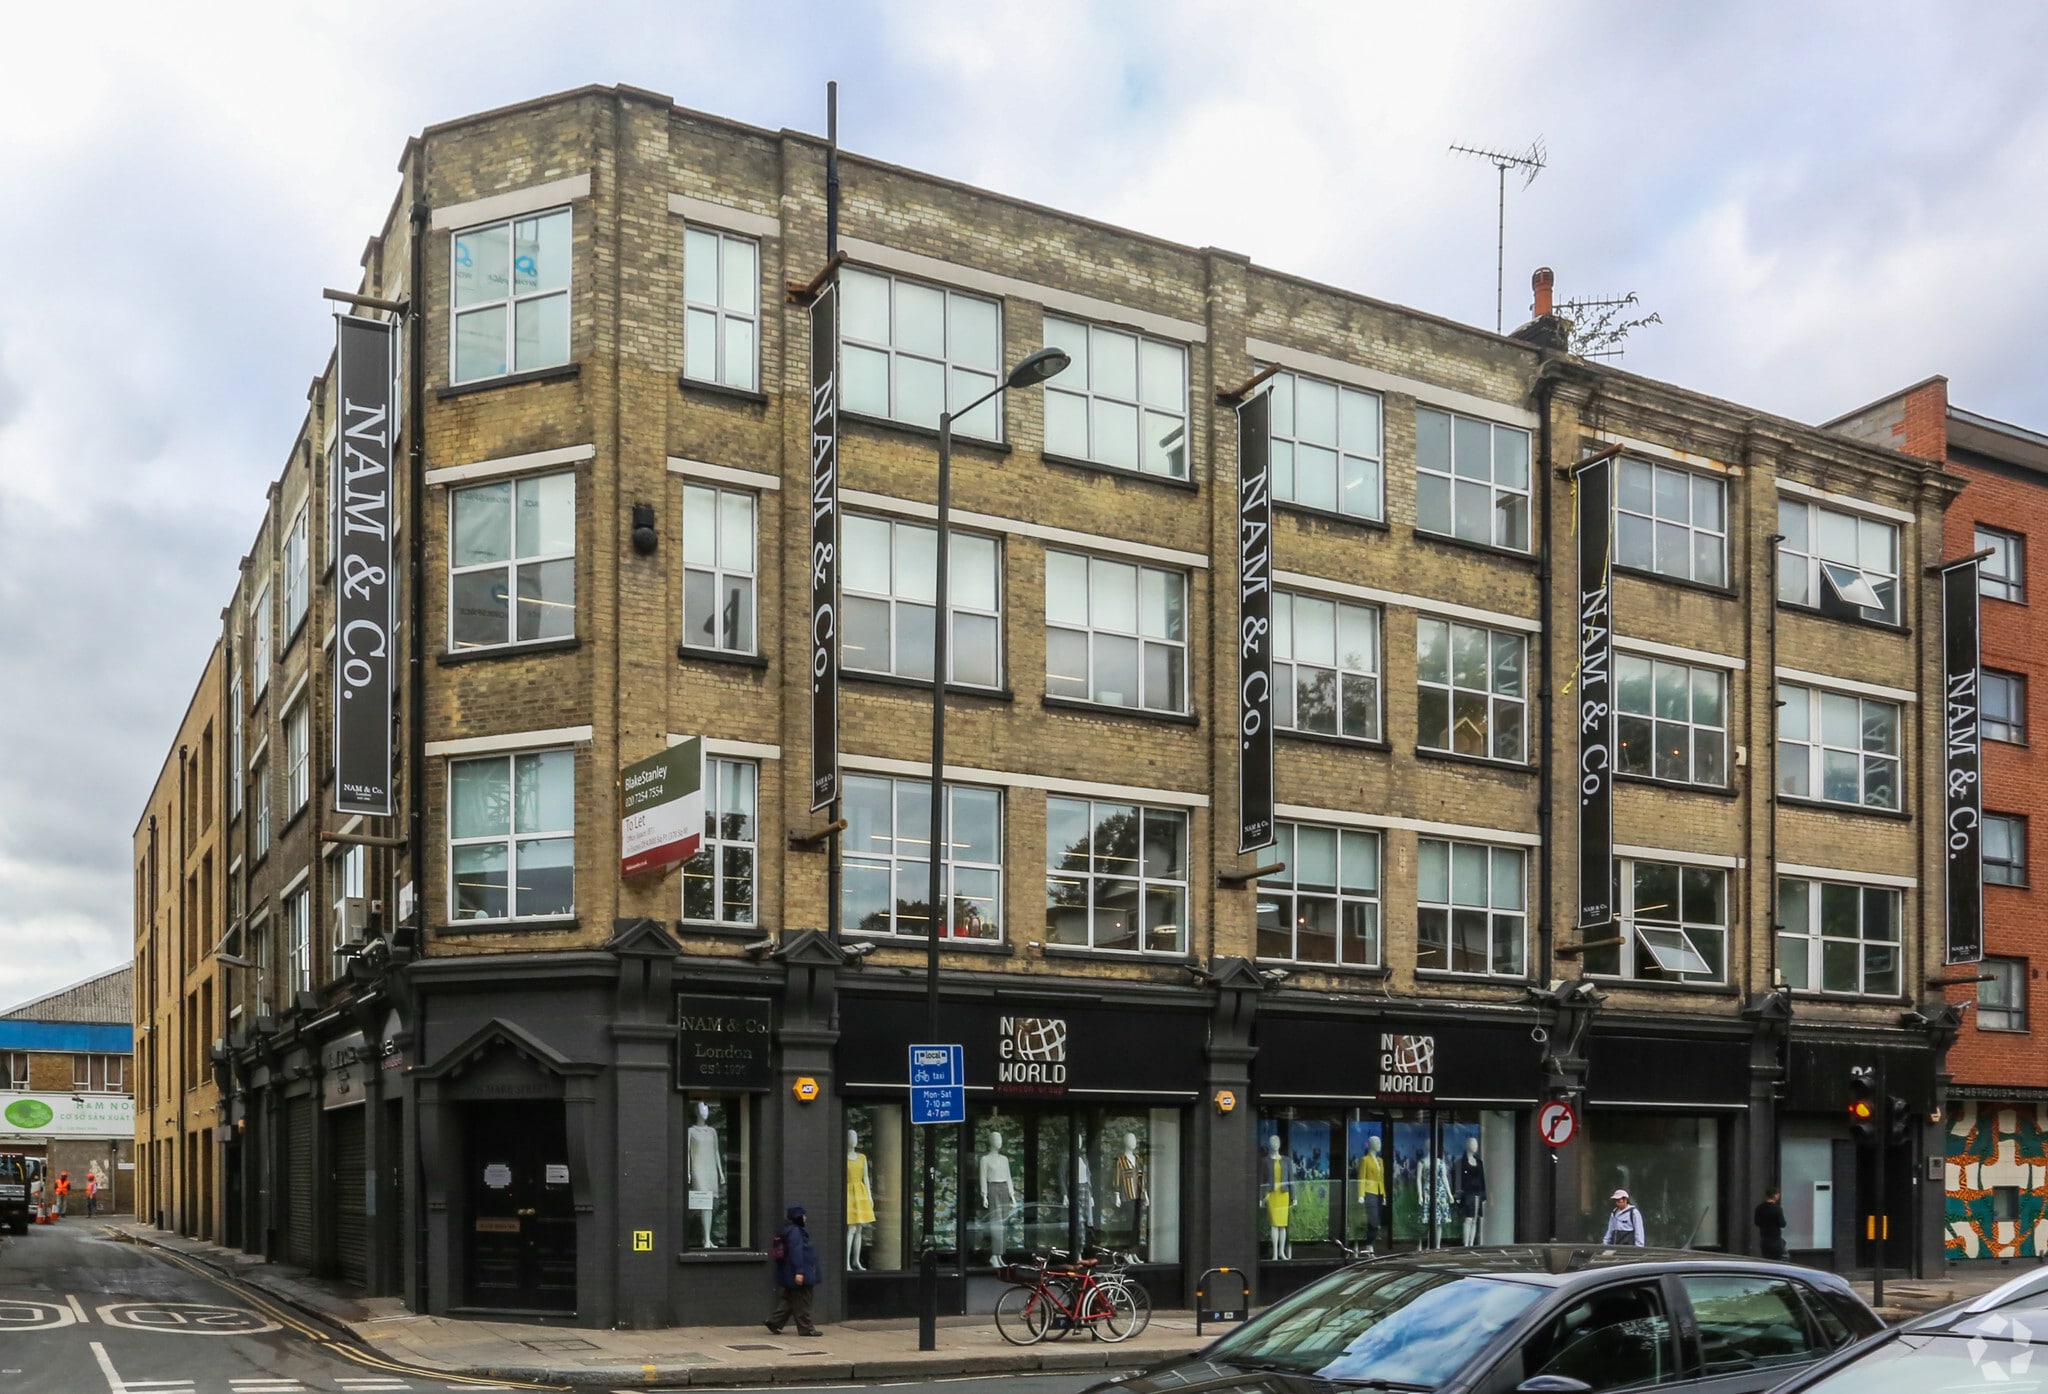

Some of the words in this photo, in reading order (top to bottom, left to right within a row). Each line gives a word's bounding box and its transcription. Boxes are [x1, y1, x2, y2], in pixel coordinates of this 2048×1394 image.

[814, 370, 833, 527] NAM
[344, 397, 387, 541] NAM
[1241, 464, 1268, 603] NAM
[343, 553, 386, 601] &
[814, 541, 834, 591] &
[814, 603, 834, 693] Co.
[1242, 615, 1269, 659] &
[1582, 584, 1608, 691] NAM
[342, 619, 387, 700] Co.
[1242, 670, 1270, 750] Co.
[1582, 700, 1608, 734] &
[1948, 667, 1977, 760] NAM
[343, 783, 363, 793] NAM
[625, 765, 667, 791] BlakeStanley
[1582, 744, 1609, 806] Co.
[1948, 768, 1977, 800] &
[625, 818, 634, 833] To
[634, 815, 646, 829] Let
[1949, 806, 1978, 860] Co.
[680, 1016, 722, 1032] NAM
[726, 1017, 738, 1033] &
[745, 1018, 769, 1033] Co.
[695, 1043, 753, 1059] London
[926, 1051, 942, 1059] local
[932, 1072, 945, 1080] taxi
[999, 1062, 1066, 1083] WORLD
[1379, 1074, 1434, 1093] WORLD
[923, 1091, 952, 1099] Mon-Sat
[925, 1100, 941, 1108] 7-10
[927, 1109, 939, 1117] 4-7
